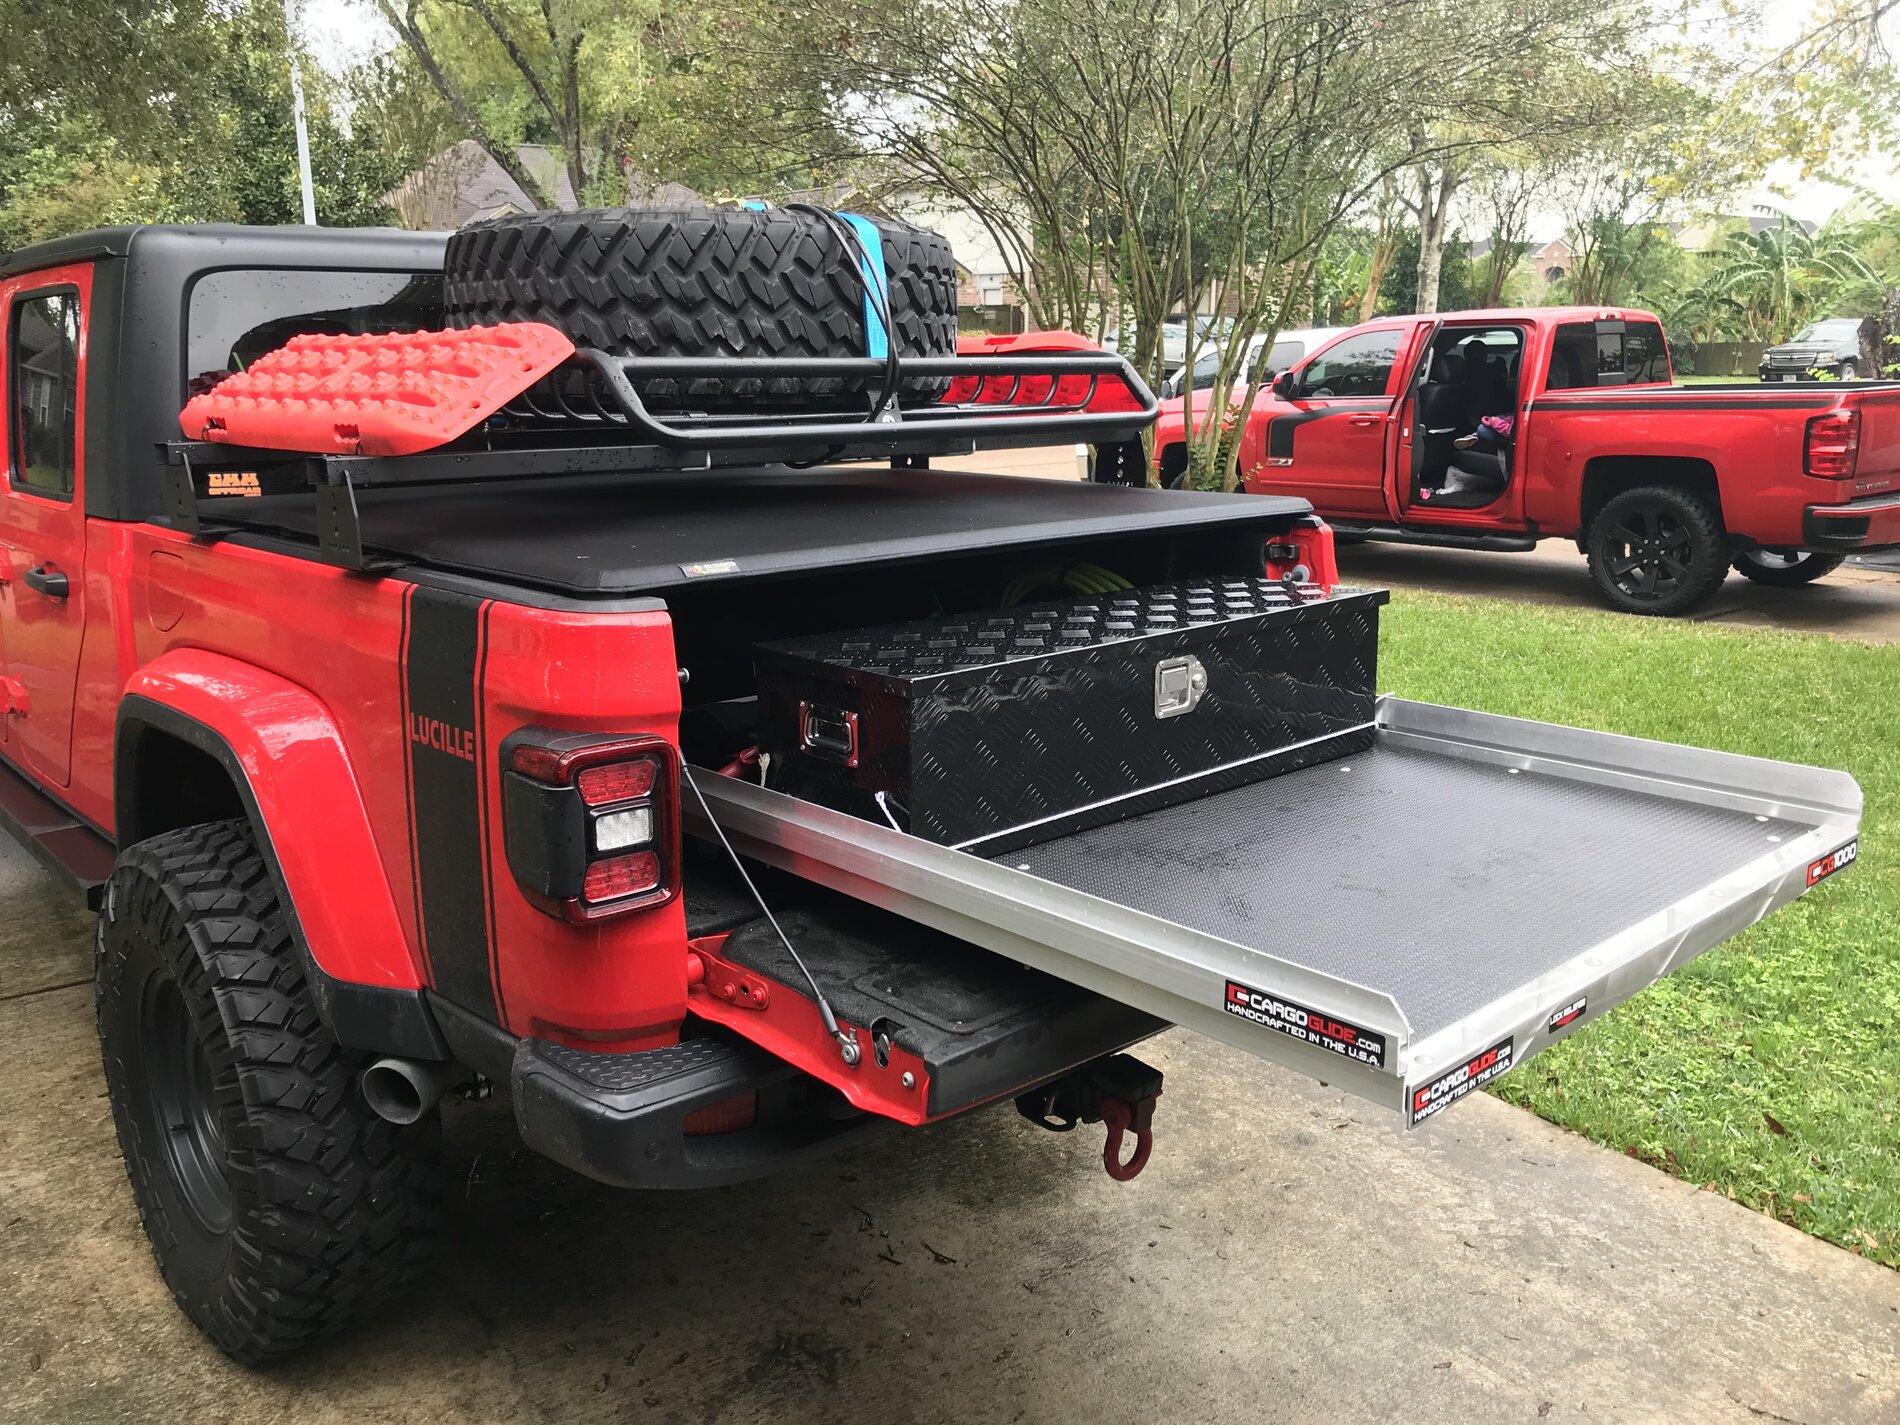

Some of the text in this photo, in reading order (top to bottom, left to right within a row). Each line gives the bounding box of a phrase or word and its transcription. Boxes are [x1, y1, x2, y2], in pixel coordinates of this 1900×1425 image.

[410, 712, 474, 762] LUCILLE
[1227, 1002, 1380, 1067] HANDCRAFTED IN THE U.S.A.
[1414, 1082, 1468, 1123] HANDCRAFTED
[1469, 1078, 1477, 1089] IN
[1477, 1069, 1492, 1084] THE
